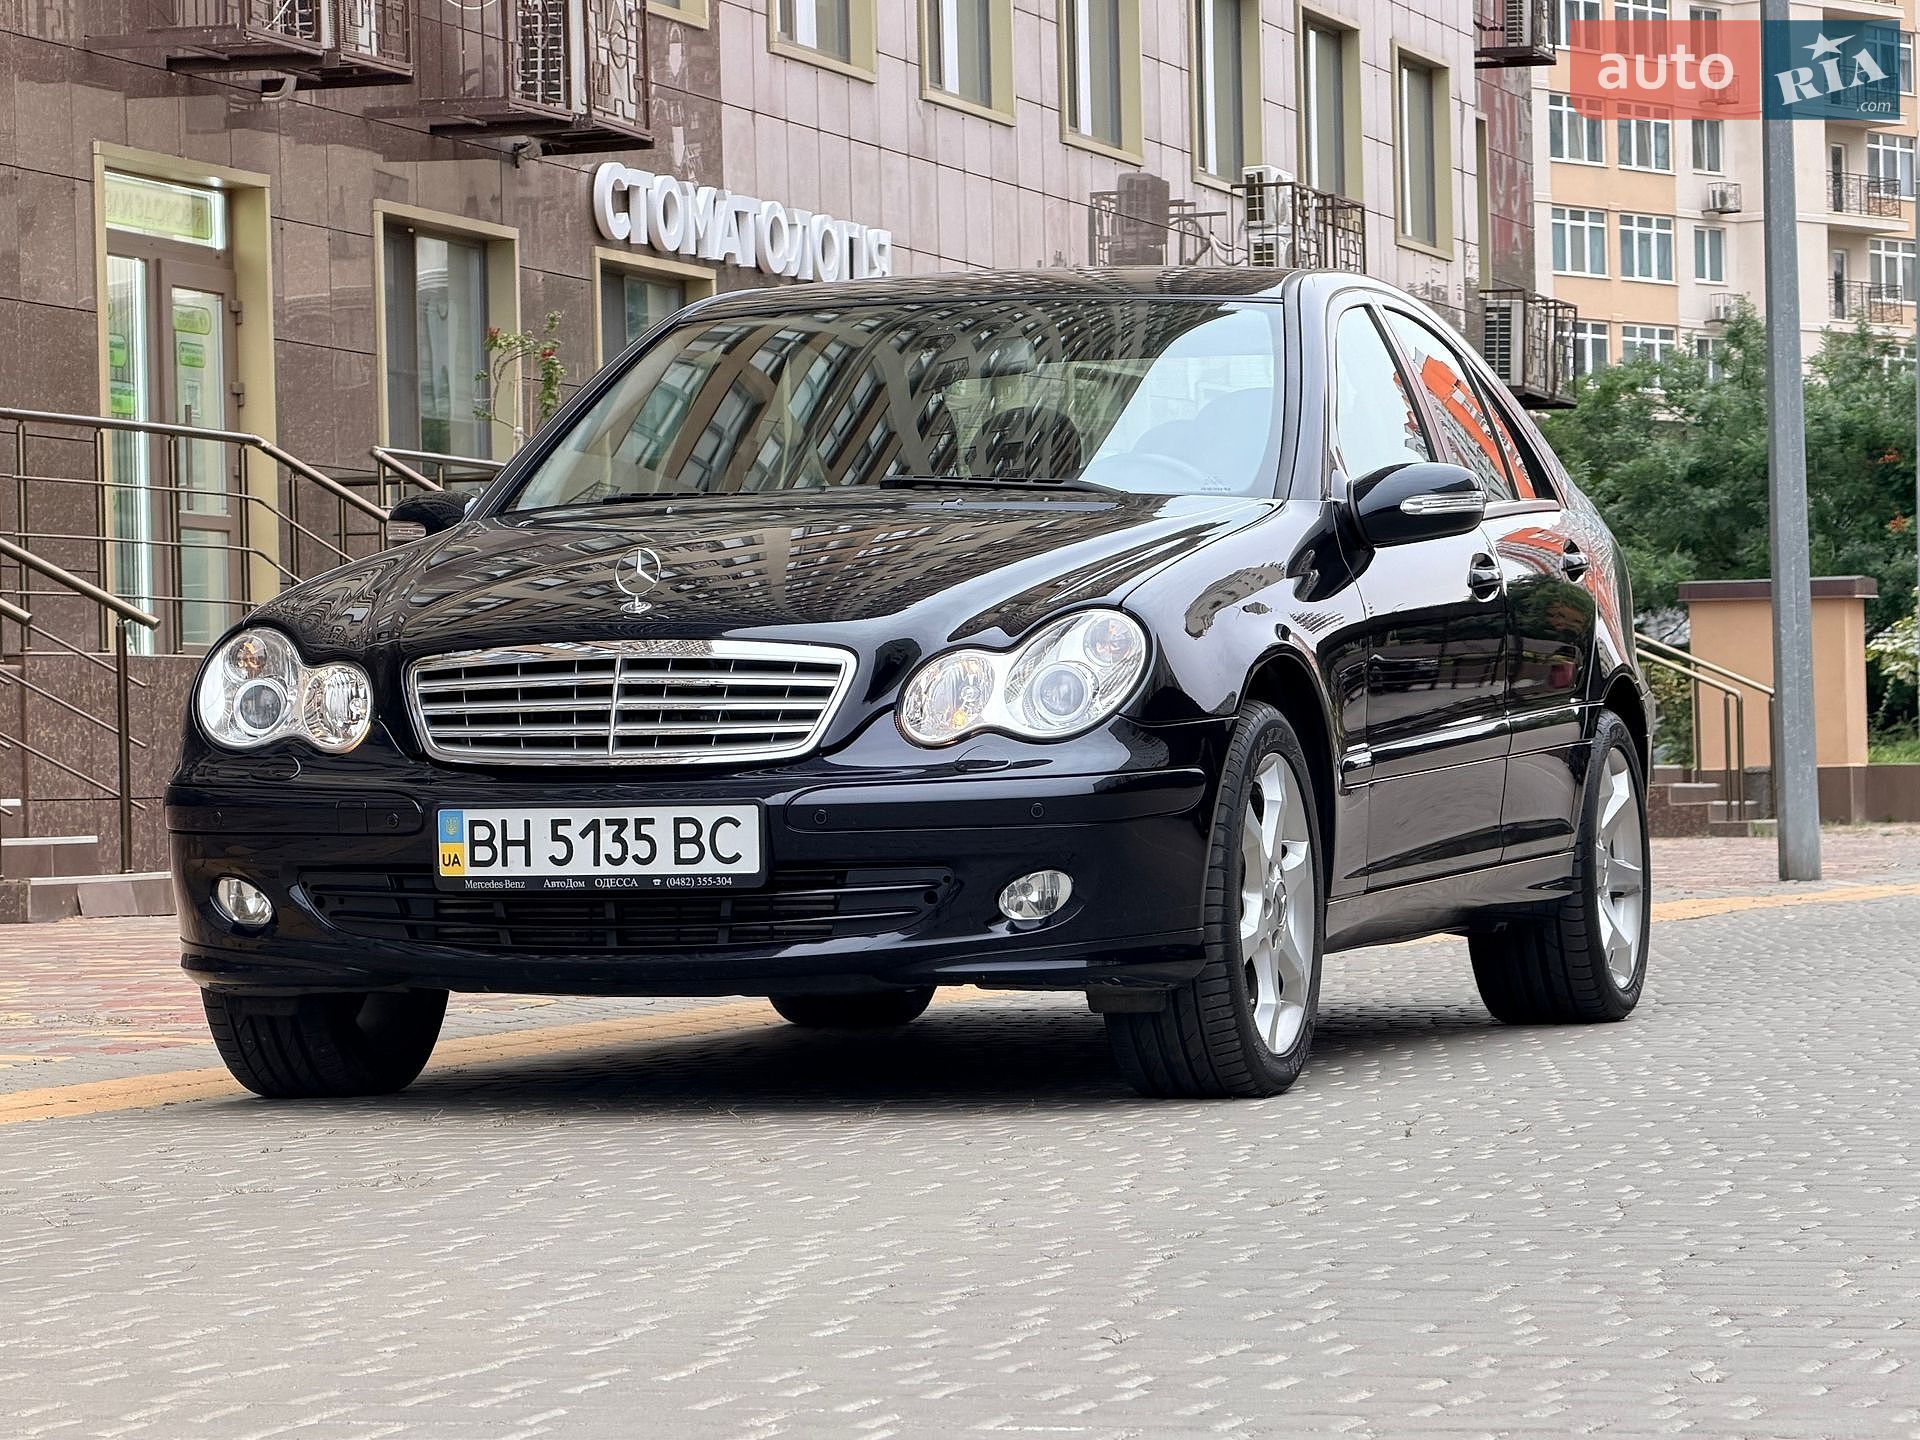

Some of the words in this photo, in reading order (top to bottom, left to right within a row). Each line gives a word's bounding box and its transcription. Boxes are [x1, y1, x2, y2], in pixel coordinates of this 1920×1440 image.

[593, 161, 892, 282] СТОМАТОЛОГІЯ
[468, 818, 531, 867] BH
[548, 817, 657, 867] 5135
[673, 816, 742, 866] BC
[442, 853, 461, 867] UA
[464, 879, 526, 889] Mercedes-Benz
[543, 878, 586, 889] АвтоДом
[594, 878, 638, 888] ОДЕССА
[666, 877, 695, 888] (0482)
[696, 876, 732, 887] 355-304
